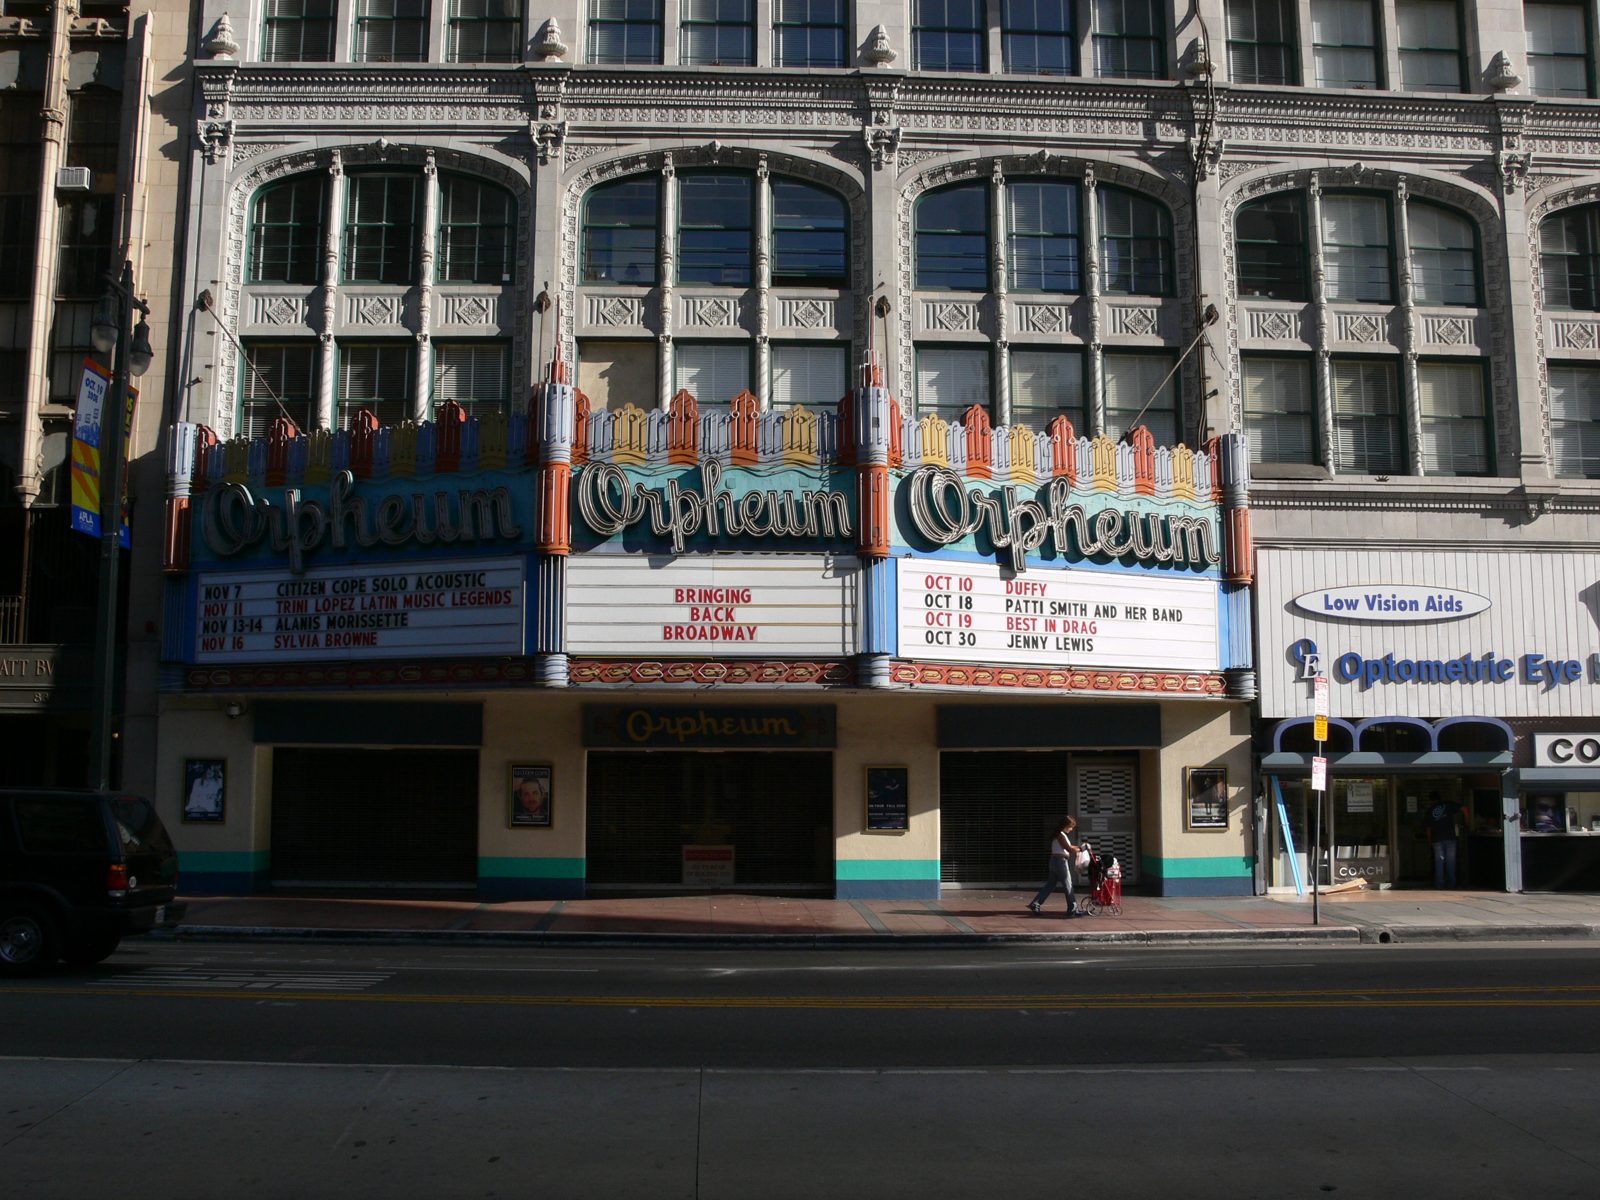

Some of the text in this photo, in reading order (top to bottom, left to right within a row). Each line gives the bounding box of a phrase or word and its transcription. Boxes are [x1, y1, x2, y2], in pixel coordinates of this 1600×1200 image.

[578, 457, 854, 552] Orpheum
[201, 469, 522, 574] Orpheum
[910, 463, 1221, 574] Orpheum
[205, 572, 485, 600] NOV 7 CITIZEN COPE SOLO ACOUSTIC
[675, 588, 752, 603] BRINGING
[925, 575, 1047, 596] OCT 10 DUFFY
[204, 603, 228, 617] NOV
[276, 600, 308, 614] TRINI
[315, 598, 355, 612] LOPEZ
[361, 595, 397, 610] LATIN
[403, 592, 445, 608] MUSIC
[452, 590, 512, 606] LEGENDS
[924, 593, 1183, 622] OCT 18 PATTI SMITH AND HER BAND
[1324, 594, 1463, 612] Low Vision Aids
[203, 612, 408, 633] NOV 13-14 ALANIS MORISSETTE
[690, 607, 735, 622] BACK
[925, 611, 1097, 634] OCT 19 BEST IN DRAG
[202, 632, 377, 650] NOV 16 SYLVIA BROWNE
[663, 625, 758, 641] BROADWAY
[925, 630, 1094, 652] OCT 30 JENNY LEWIS
[1339, 651, 1515, 689] Optometric
[1525, 653, 1582, 692] Eye
[625, 708, 798, 742] Orpheum
[1339, 866, 1384, 877] COACH
